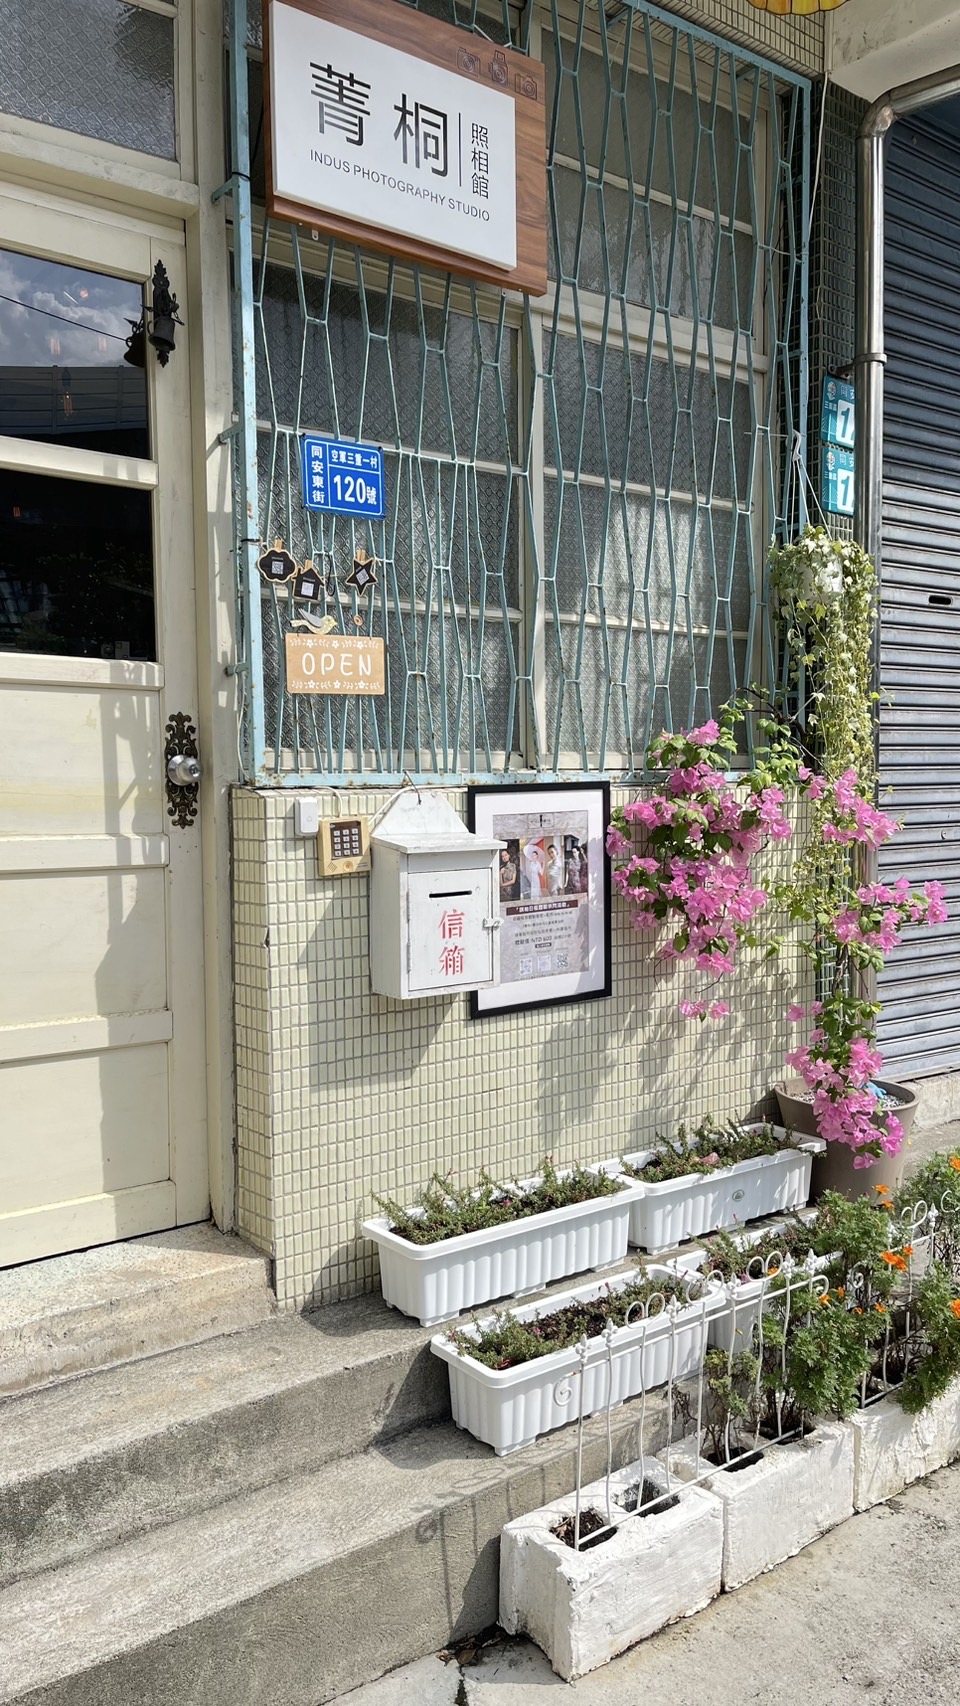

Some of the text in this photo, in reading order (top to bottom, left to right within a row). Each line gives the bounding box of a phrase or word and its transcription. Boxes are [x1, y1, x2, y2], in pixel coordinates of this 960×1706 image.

[310, 61, 448, 178] 菁桐
[310, 149, 490, 222] INDUS PHOTOGRAPHY STUDIO
[471, 122, 489, 200] 照相館
[311, 445, 325, 504] 同安東街
[331, 449, 378, 469] 空軍三重一村
[333, 474, 377, 505] 120號
[301, 652, 372, 677] OPEN
[438, 909, 466, 976] 信箱
